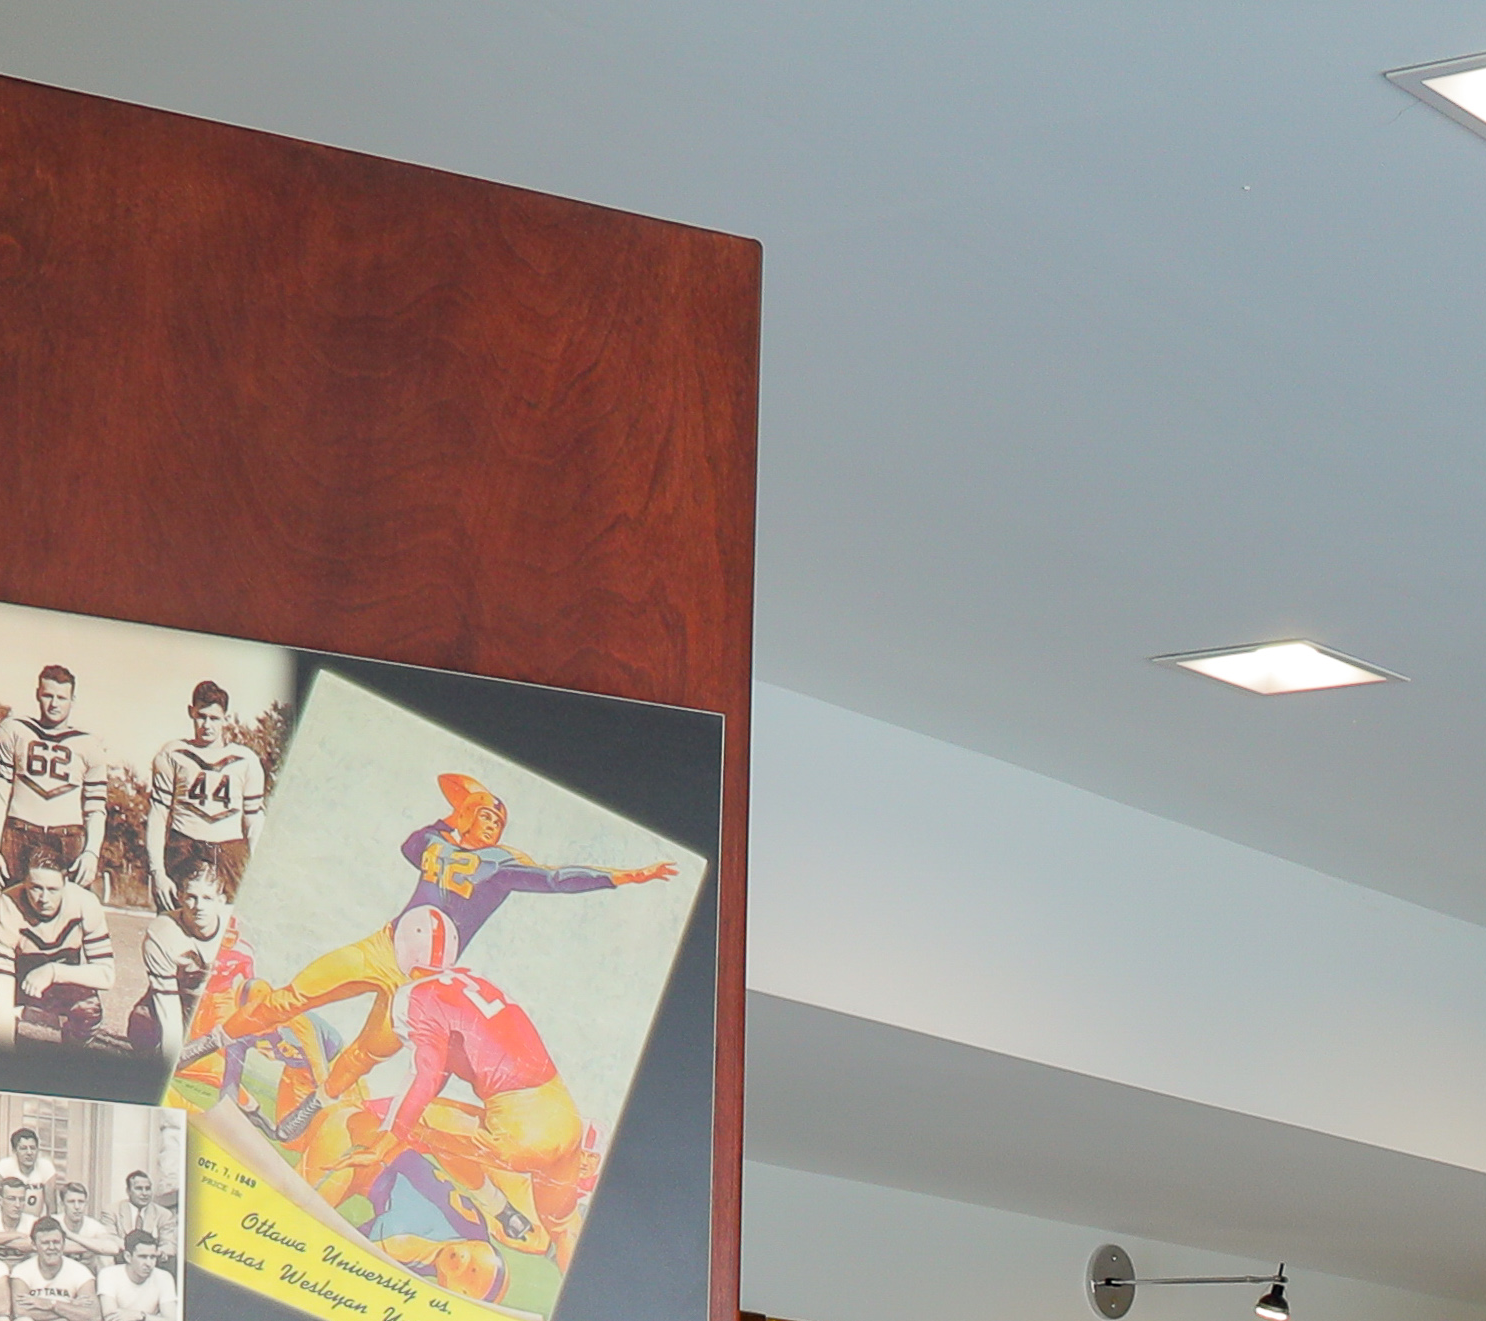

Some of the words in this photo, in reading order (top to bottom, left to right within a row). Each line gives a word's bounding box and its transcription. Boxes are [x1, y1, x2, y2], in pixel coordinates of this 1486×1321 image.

[27, 740, 72, 780] 62
[188, 771, 230, 806] 44
[198, 1157, 218, 1173] OCT.
[234, 1173, 257, 1188] 1949
[195, 1231, 267, 1272] Kansas
[279, 1264, 369, 1314] Wesleyan
[240, 1212, 307, 1254] Ottawa
[322, 1245, 417, 1304] University
[429, 1297, 453, 1315] vs.
